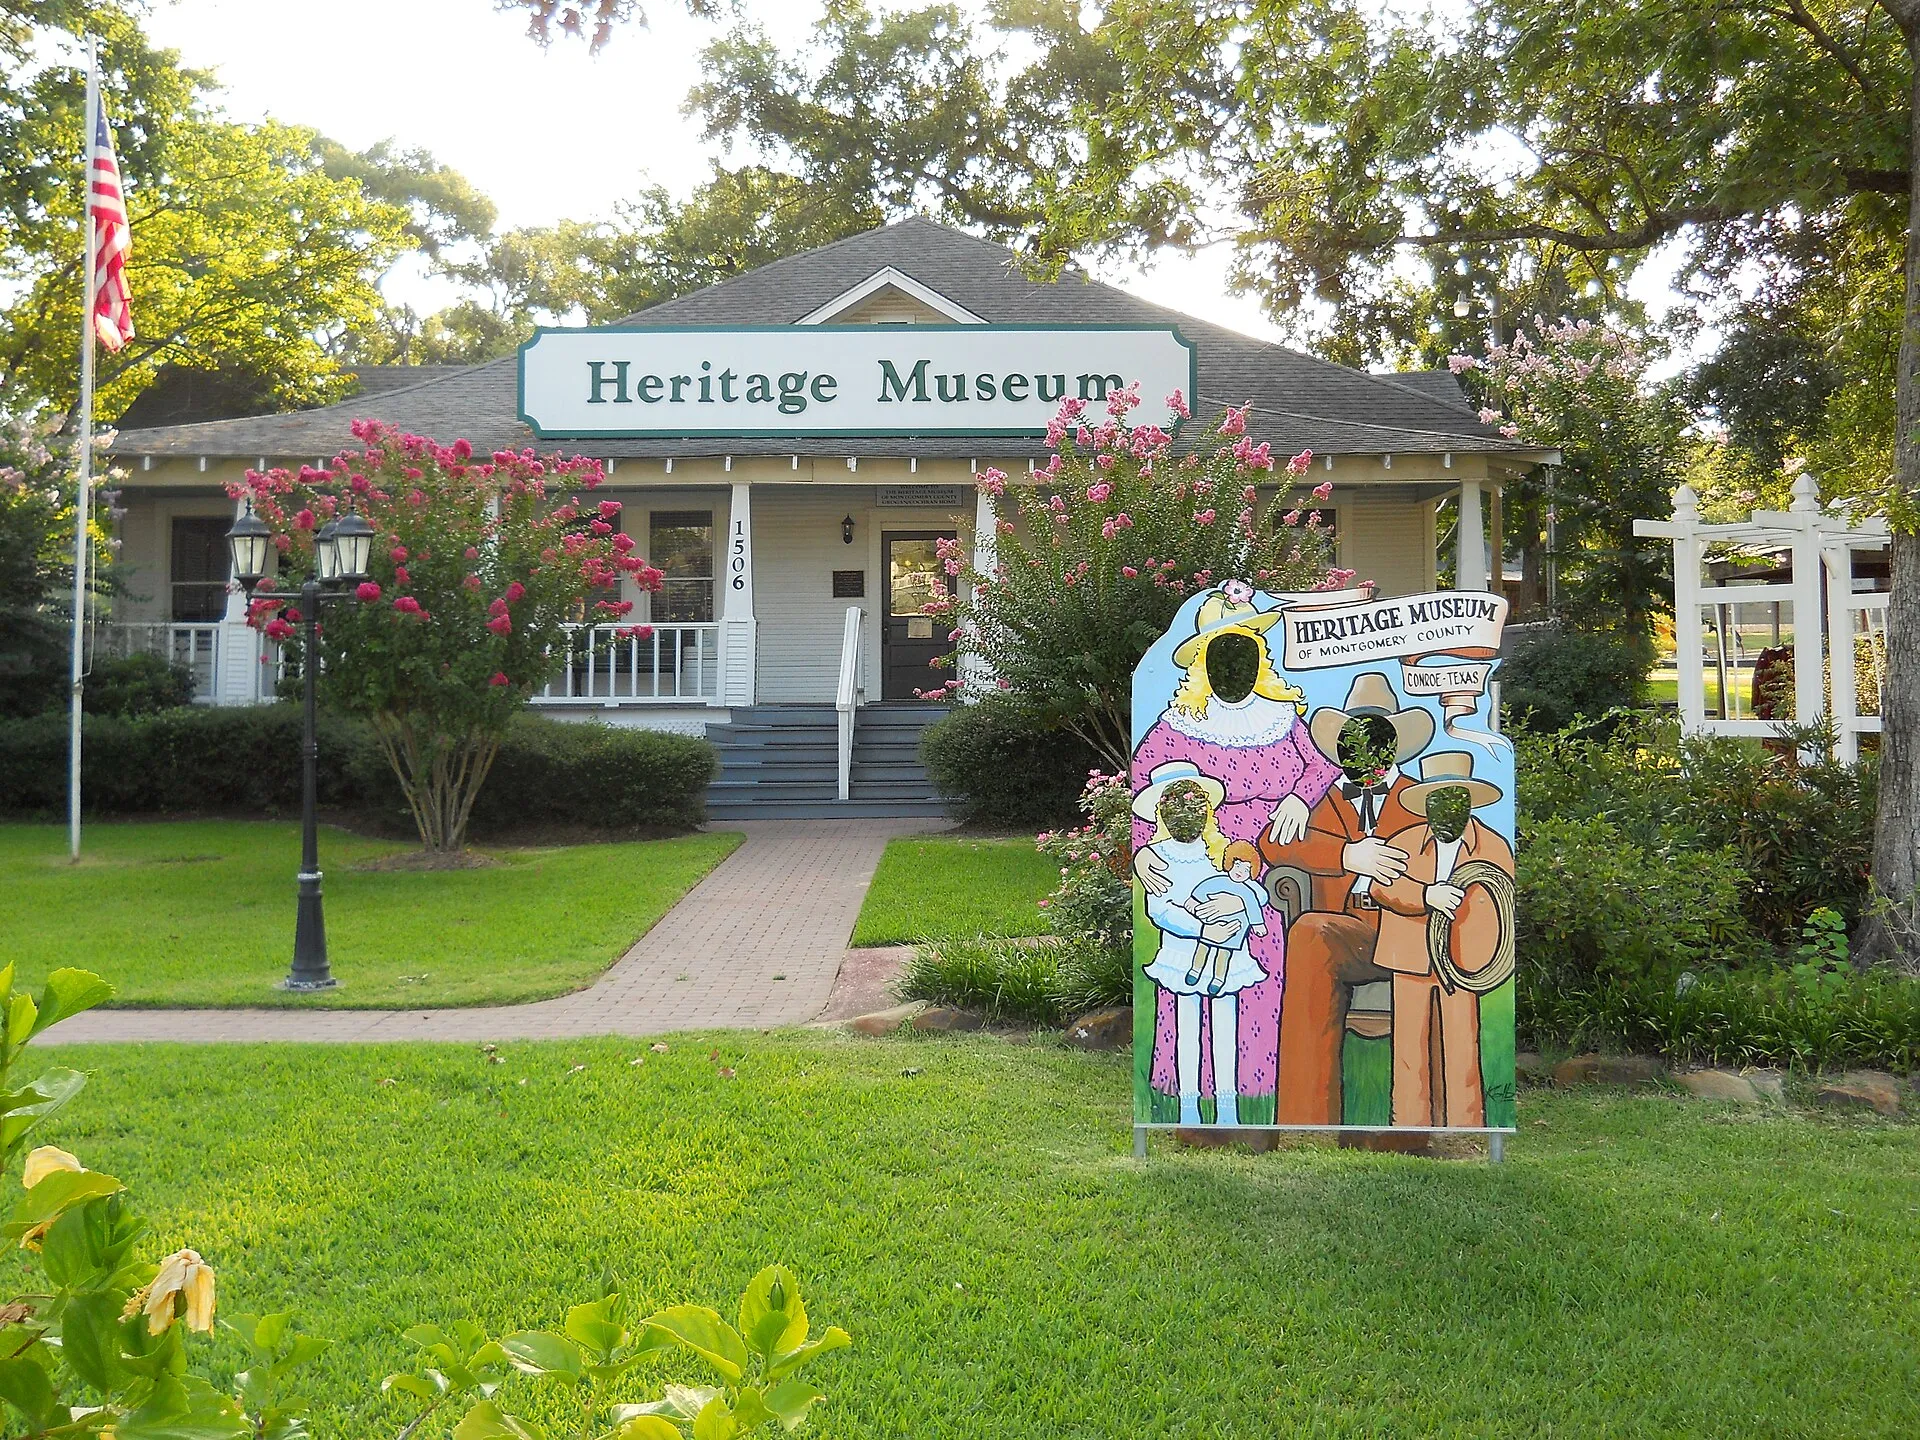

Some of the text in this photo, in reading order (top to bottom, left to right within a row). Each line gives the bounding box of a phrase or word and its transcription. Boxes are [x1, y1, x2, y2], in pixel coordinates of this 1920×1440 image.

[585, 359, 1126, 415] Heritage Museum
[732, 520, 745, 590] 1506
[1293, 597, 1499, 643] HERITAGE MUSEUM
[1298, 625, 1475, 660] OF MONTGOMERY COUNTY
